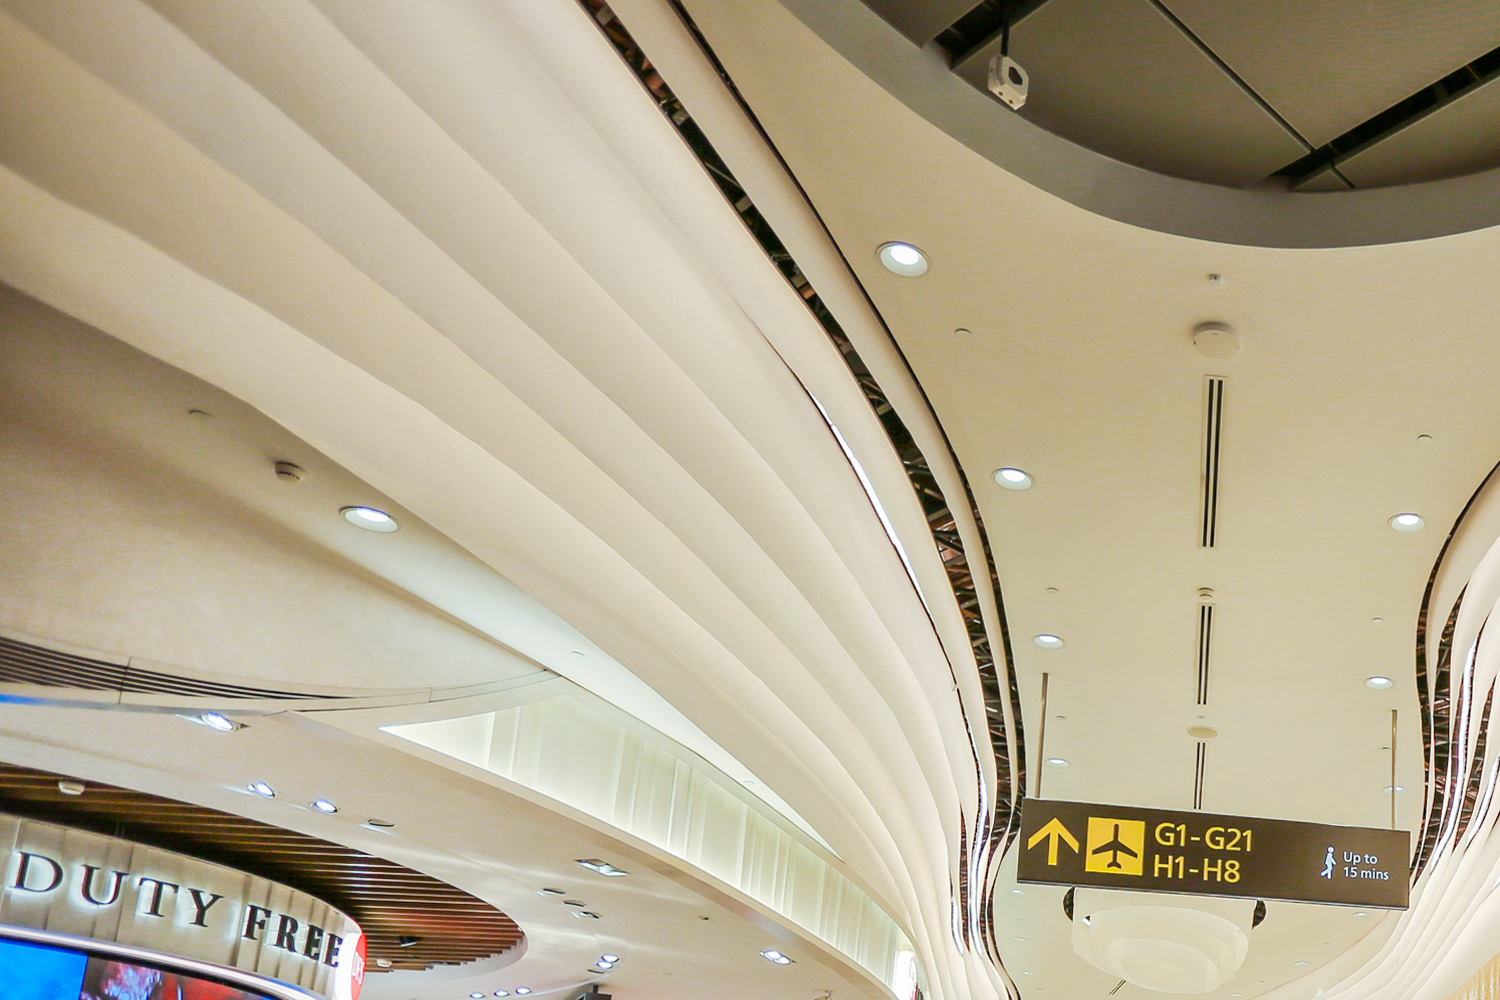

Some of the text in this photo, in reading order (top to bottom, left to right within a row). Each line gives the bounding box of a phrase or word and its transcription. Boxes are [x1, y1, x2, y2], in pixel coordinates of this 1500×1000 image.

[1343, 850, 1379, 867] Up to
[1343, 865, 1390, 881] 15 mins
[12, 851, 343, 968] DUTY FREE
